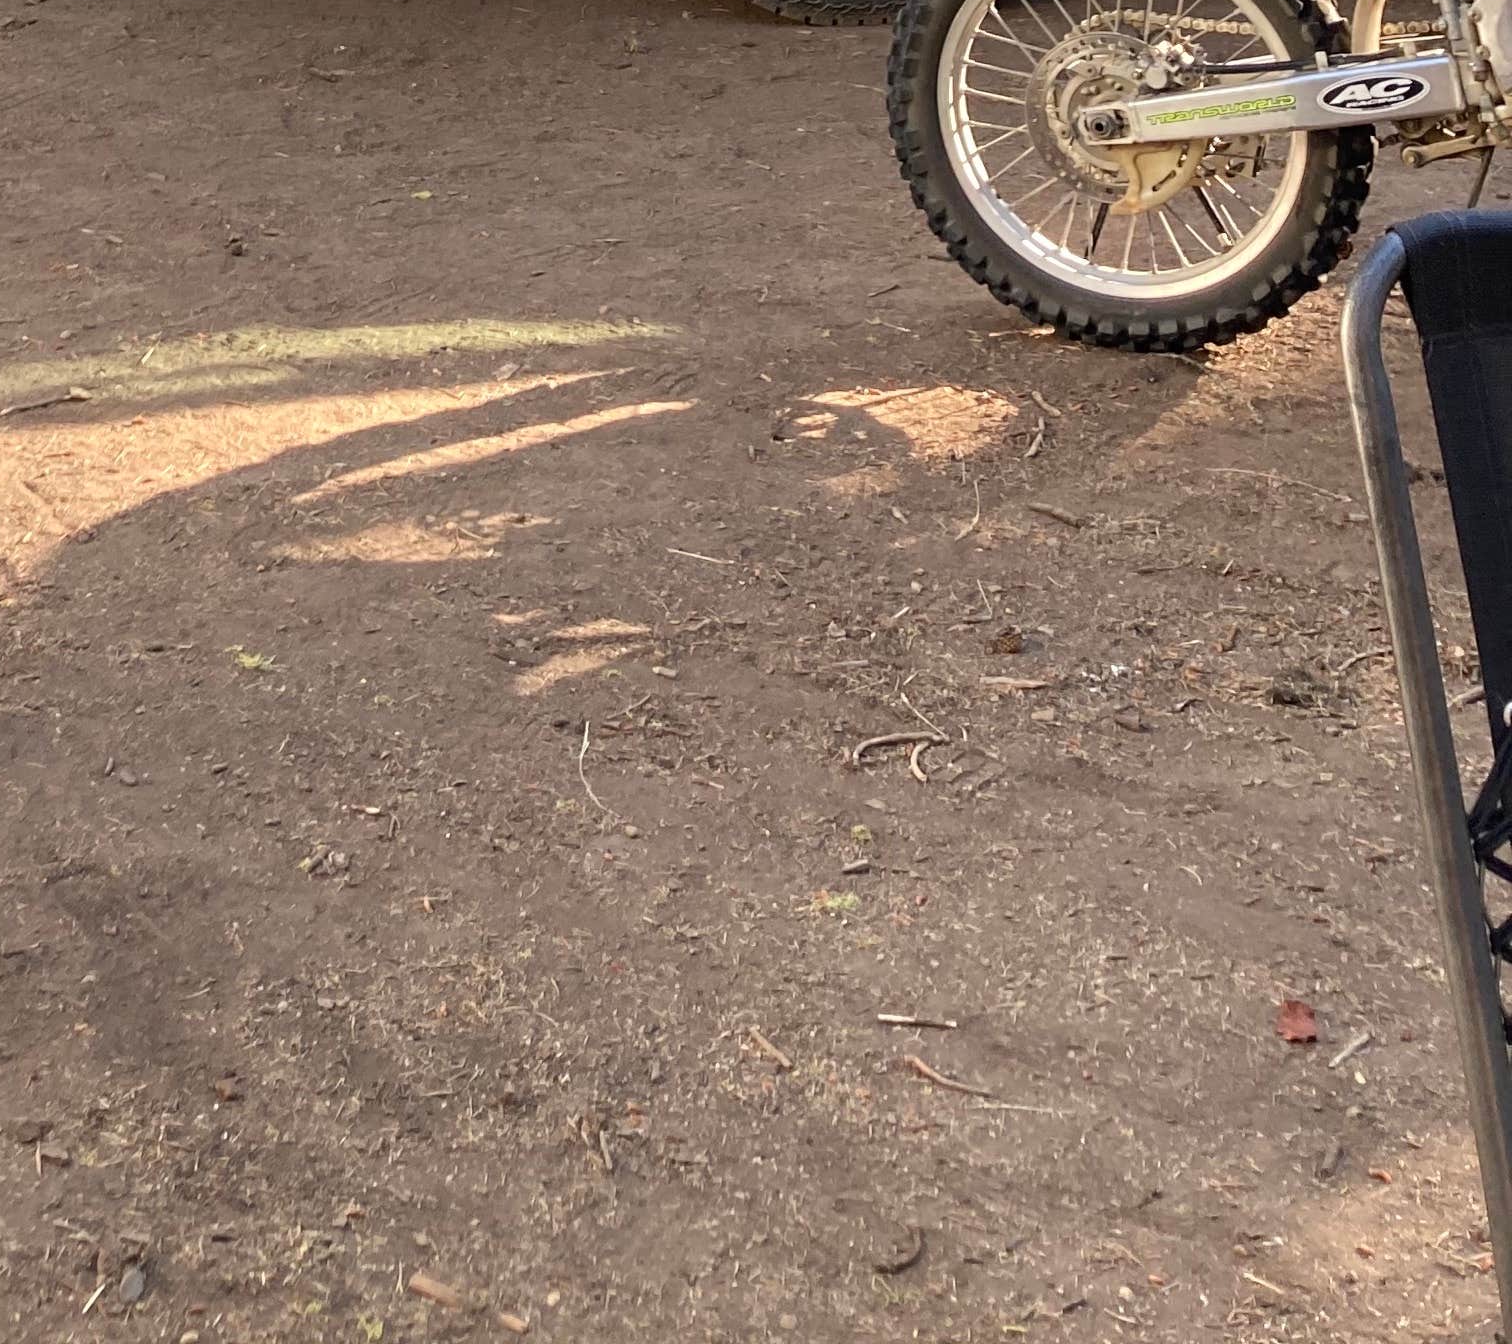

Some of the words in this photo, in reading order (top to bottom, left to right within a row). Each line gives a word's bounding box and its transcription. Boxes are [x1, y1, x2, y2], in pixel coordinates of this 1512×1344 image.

[1329, 77, 1414, 105] AC
[1345, 95, 1405, 108] RACING
[1146, 94, 1296, 125] TRANSWORLD
